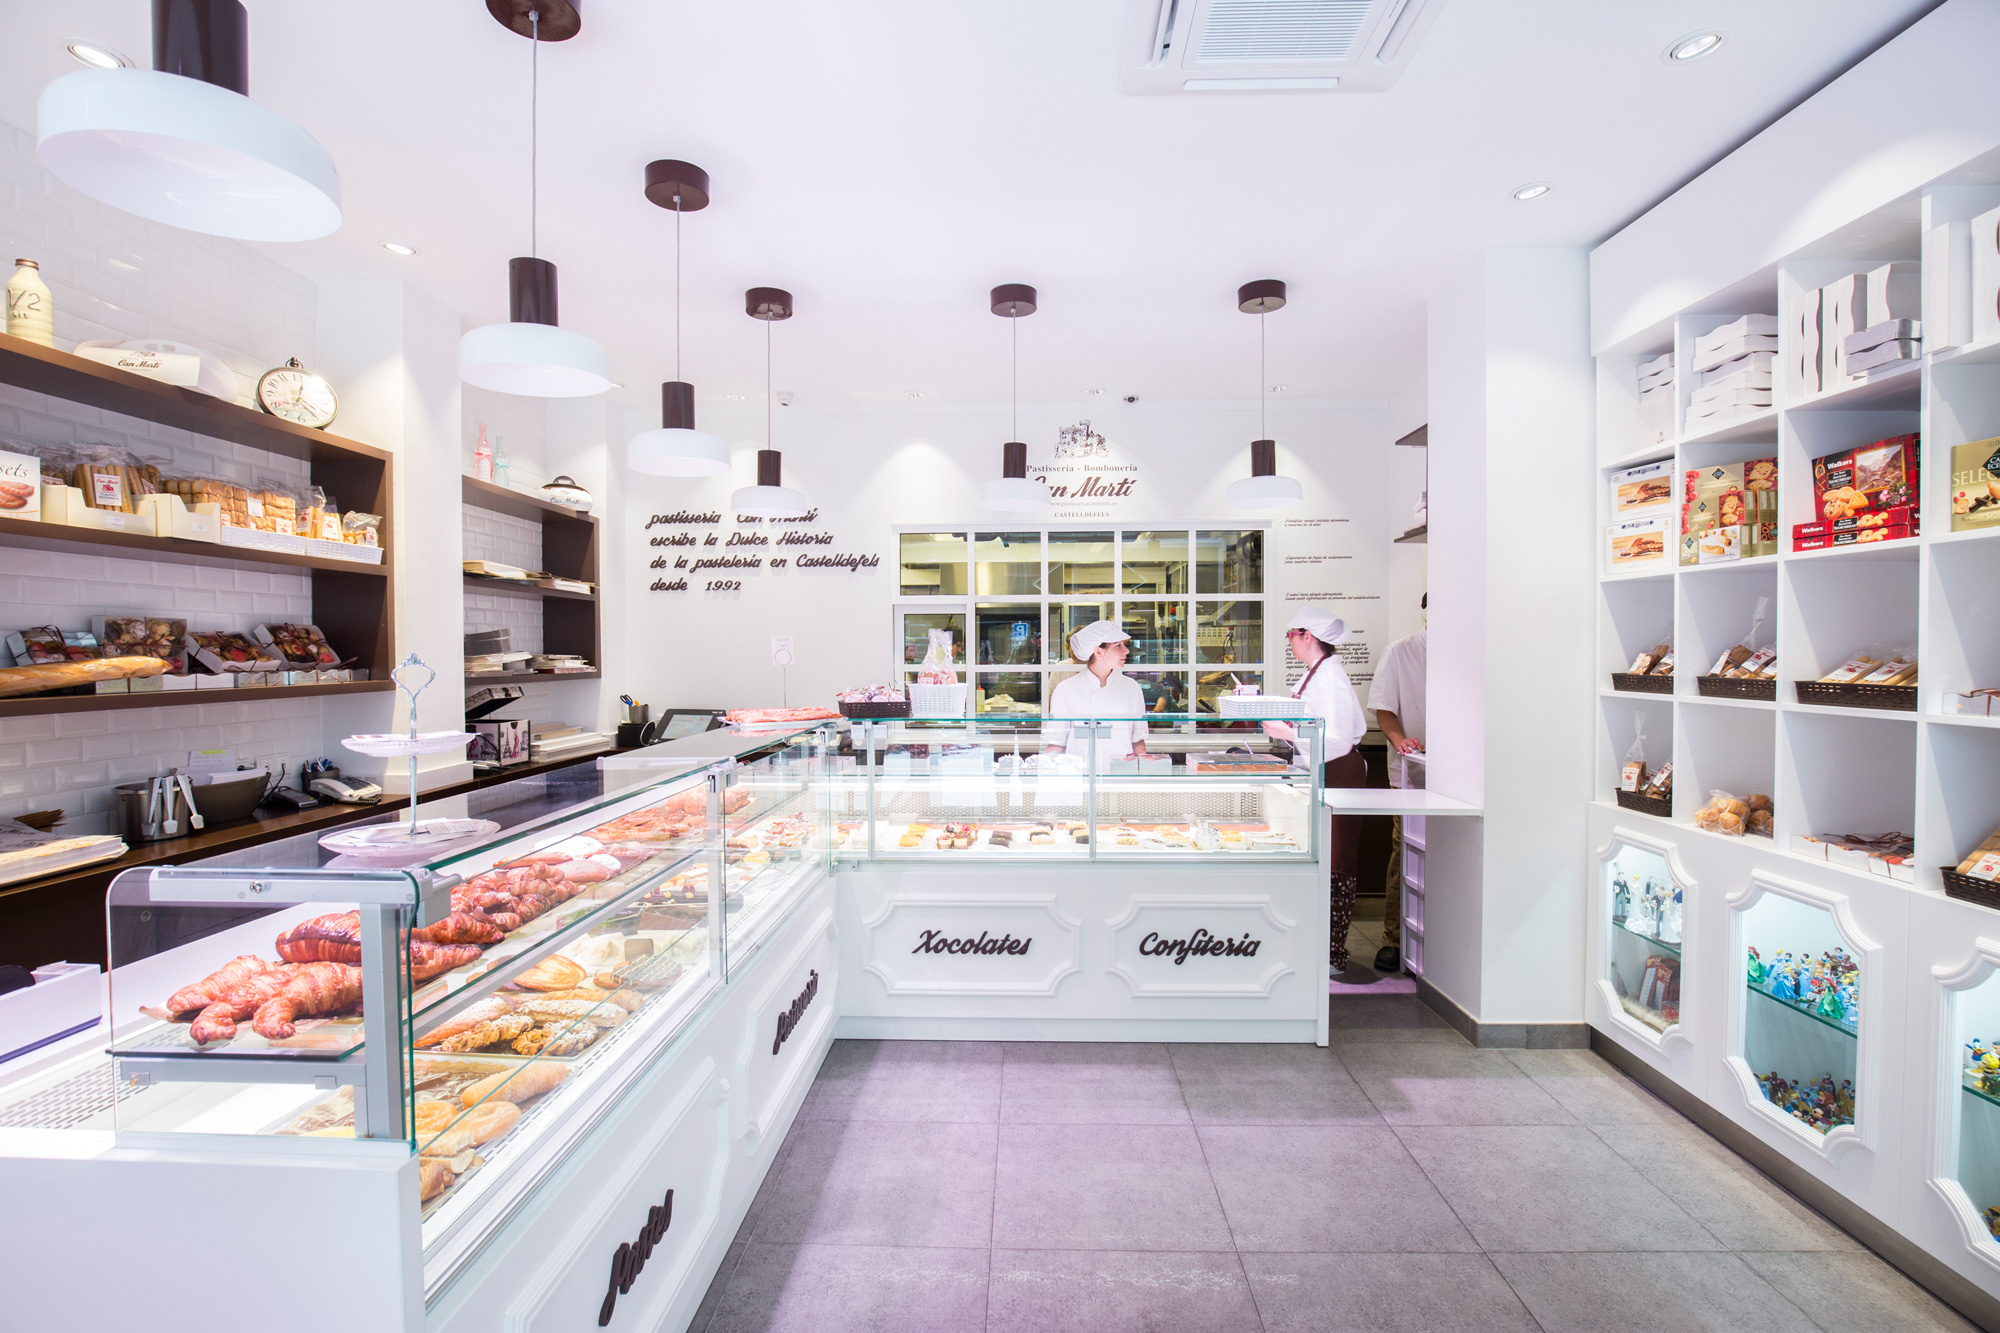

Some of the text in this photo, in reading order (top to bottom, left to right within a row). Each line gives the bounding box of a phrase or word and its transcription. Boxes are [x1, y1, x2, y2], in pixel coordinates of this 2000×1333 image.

[117, 359, 134, 367] Can
[1026, 464, 1074, 472] Pastisseria
[1084, 464, 1138, 472] Bomboneria
[1827, 459, 1853, 470] Walkers
[1070, 476, 1137, 498] Martí
[650, 531, 834, 547] escribe la Dulce Historia
[650, 553, 880, 574] de la pastelería en Castelldefels
[650, 577, 742, 592] desde 1992
[911, 930, 1032, 956] Xocolates
[1139, 928, 1262, 966] Confiteria
